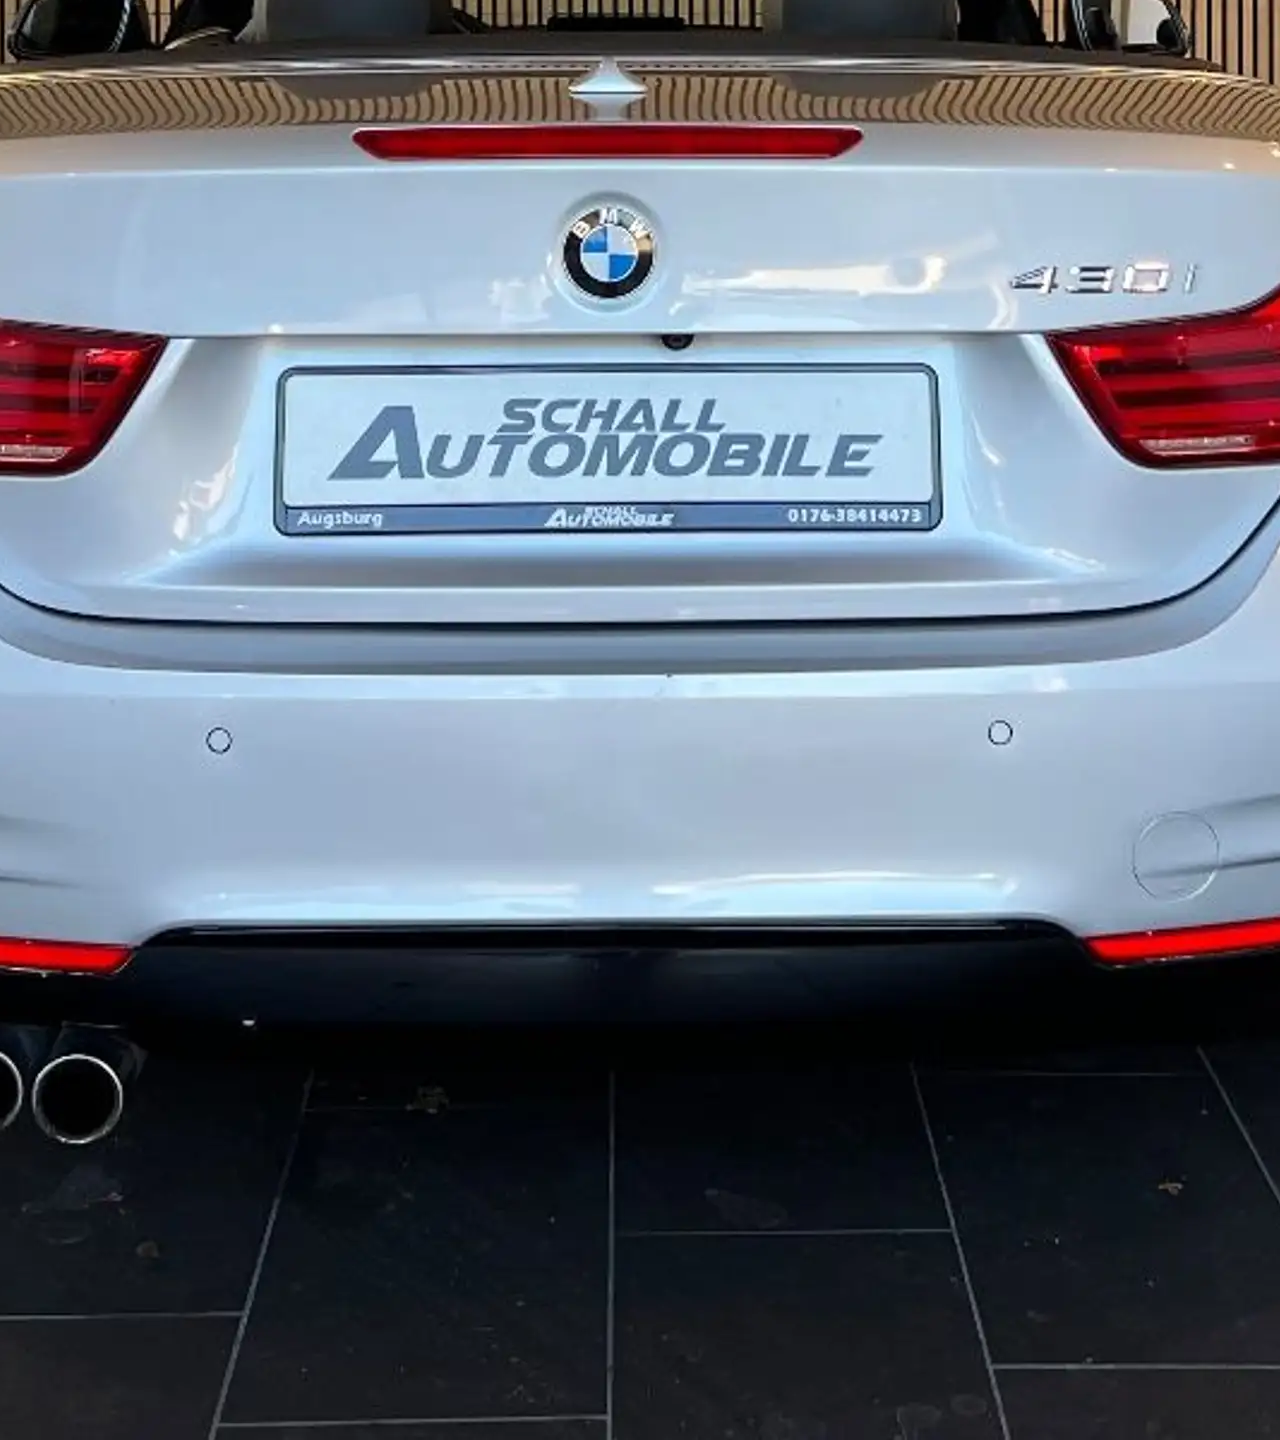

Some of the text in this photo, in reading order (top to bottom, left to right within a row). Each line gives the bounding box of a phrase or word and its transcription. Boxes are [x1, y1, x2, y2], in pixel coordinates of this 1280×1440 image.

[572, 208, 651, 238] BMW
[1010, 261, 1198, 294] 430i
[496, 397, 727, 433] SCHALL
[327, 405, 884, 480] AUTOMOBILE
[297, 511, 383, 529] Augsburg
[544, 508, 675, 527] AUTOMOBILE
[788, 508, 922, 523] 0176-38414473
